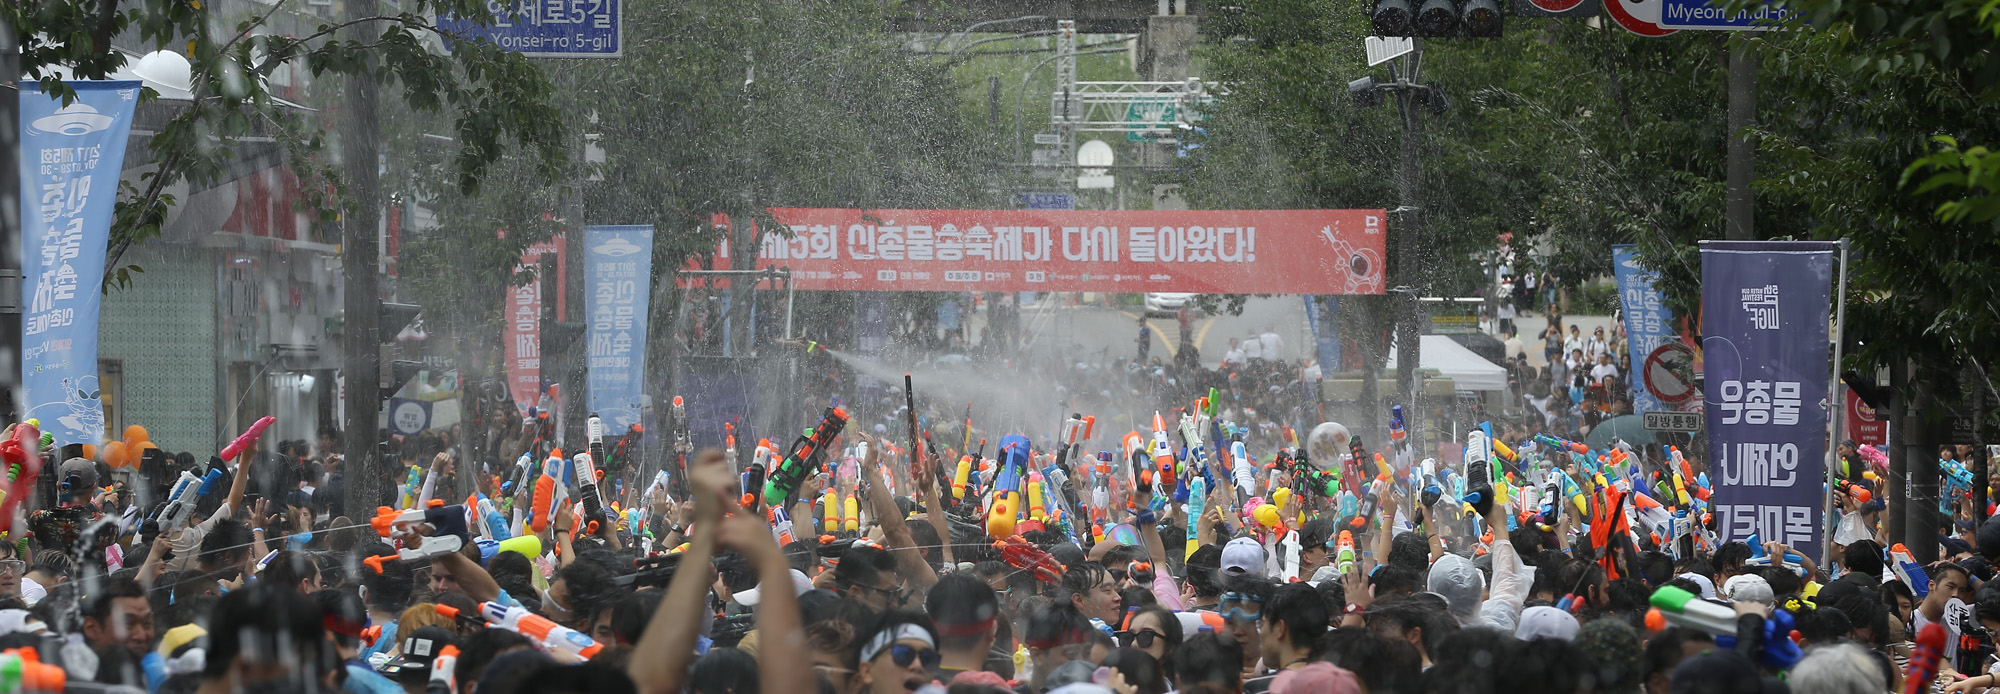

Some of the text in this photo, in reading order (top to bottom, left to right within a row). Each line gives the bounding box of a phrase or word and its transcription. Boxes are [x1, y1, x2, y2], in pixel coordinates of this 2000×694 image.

[491, 32, 612, 51] Yonsei-ro 5-gil
[1061, 225, 1118, 262] 다시
[1128, 226, 1256, 263] 돌아왔다!
[1647, 414, 1697, 428] 일방통행
[1952, 418, 1972, 430] 신촌
